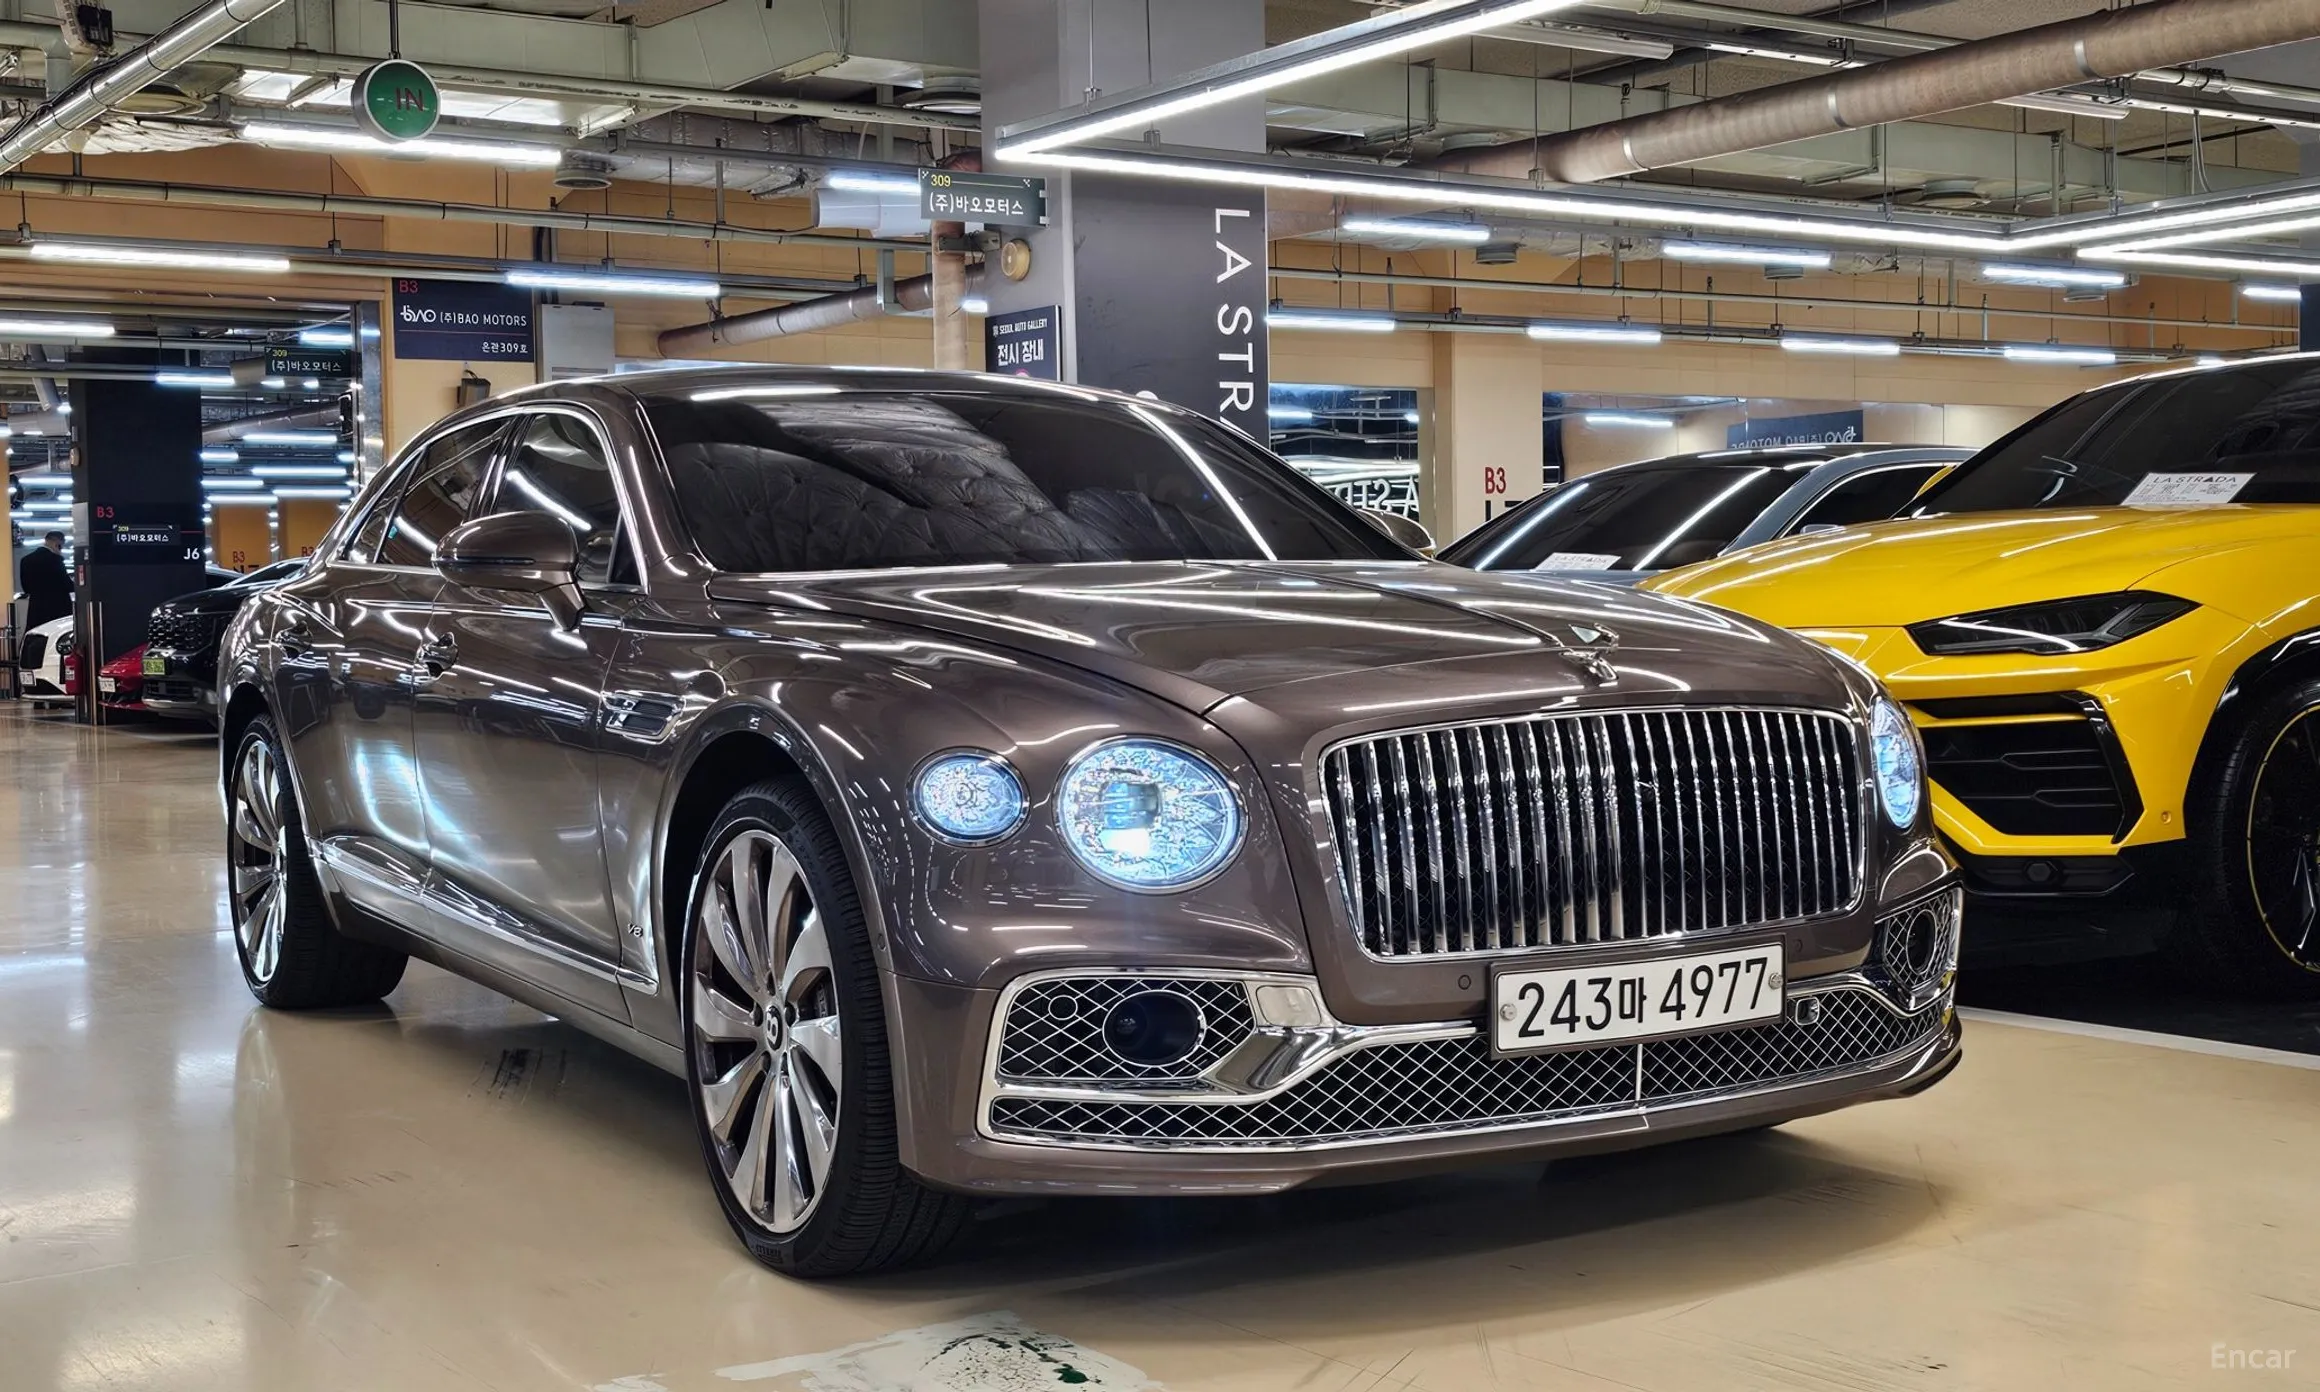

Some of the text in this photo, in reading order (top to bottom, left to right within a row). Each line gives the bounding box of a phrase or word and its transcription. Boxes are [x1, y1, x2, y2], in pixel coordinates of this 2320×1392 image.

[396, 87, 424, 111] IN
[930, 174, 951, 187] 309
[929, 192, 1024, 215] (주)바오모터스
[399, 280, 418, 293] B3
[483, 314, 527, 327] MOTORS
[999, 318, 1048, 334] SEOUL AUTO GALLERY
[1215, 208, 1256, 439] LA STR
[272, 349, 288, 357] 309
[997, 338, 1044, 367] 전시 장내
[271, 359, 342, 372] (주)바오모터스
[1485, 467, 1507, 494] B3
[2153, 476, 2172, 484] LA
[97, 506, 115, 518] B3
[183, 547, 200, 560] J6
[1517, 957, 1768, 1038] 243마 4977
